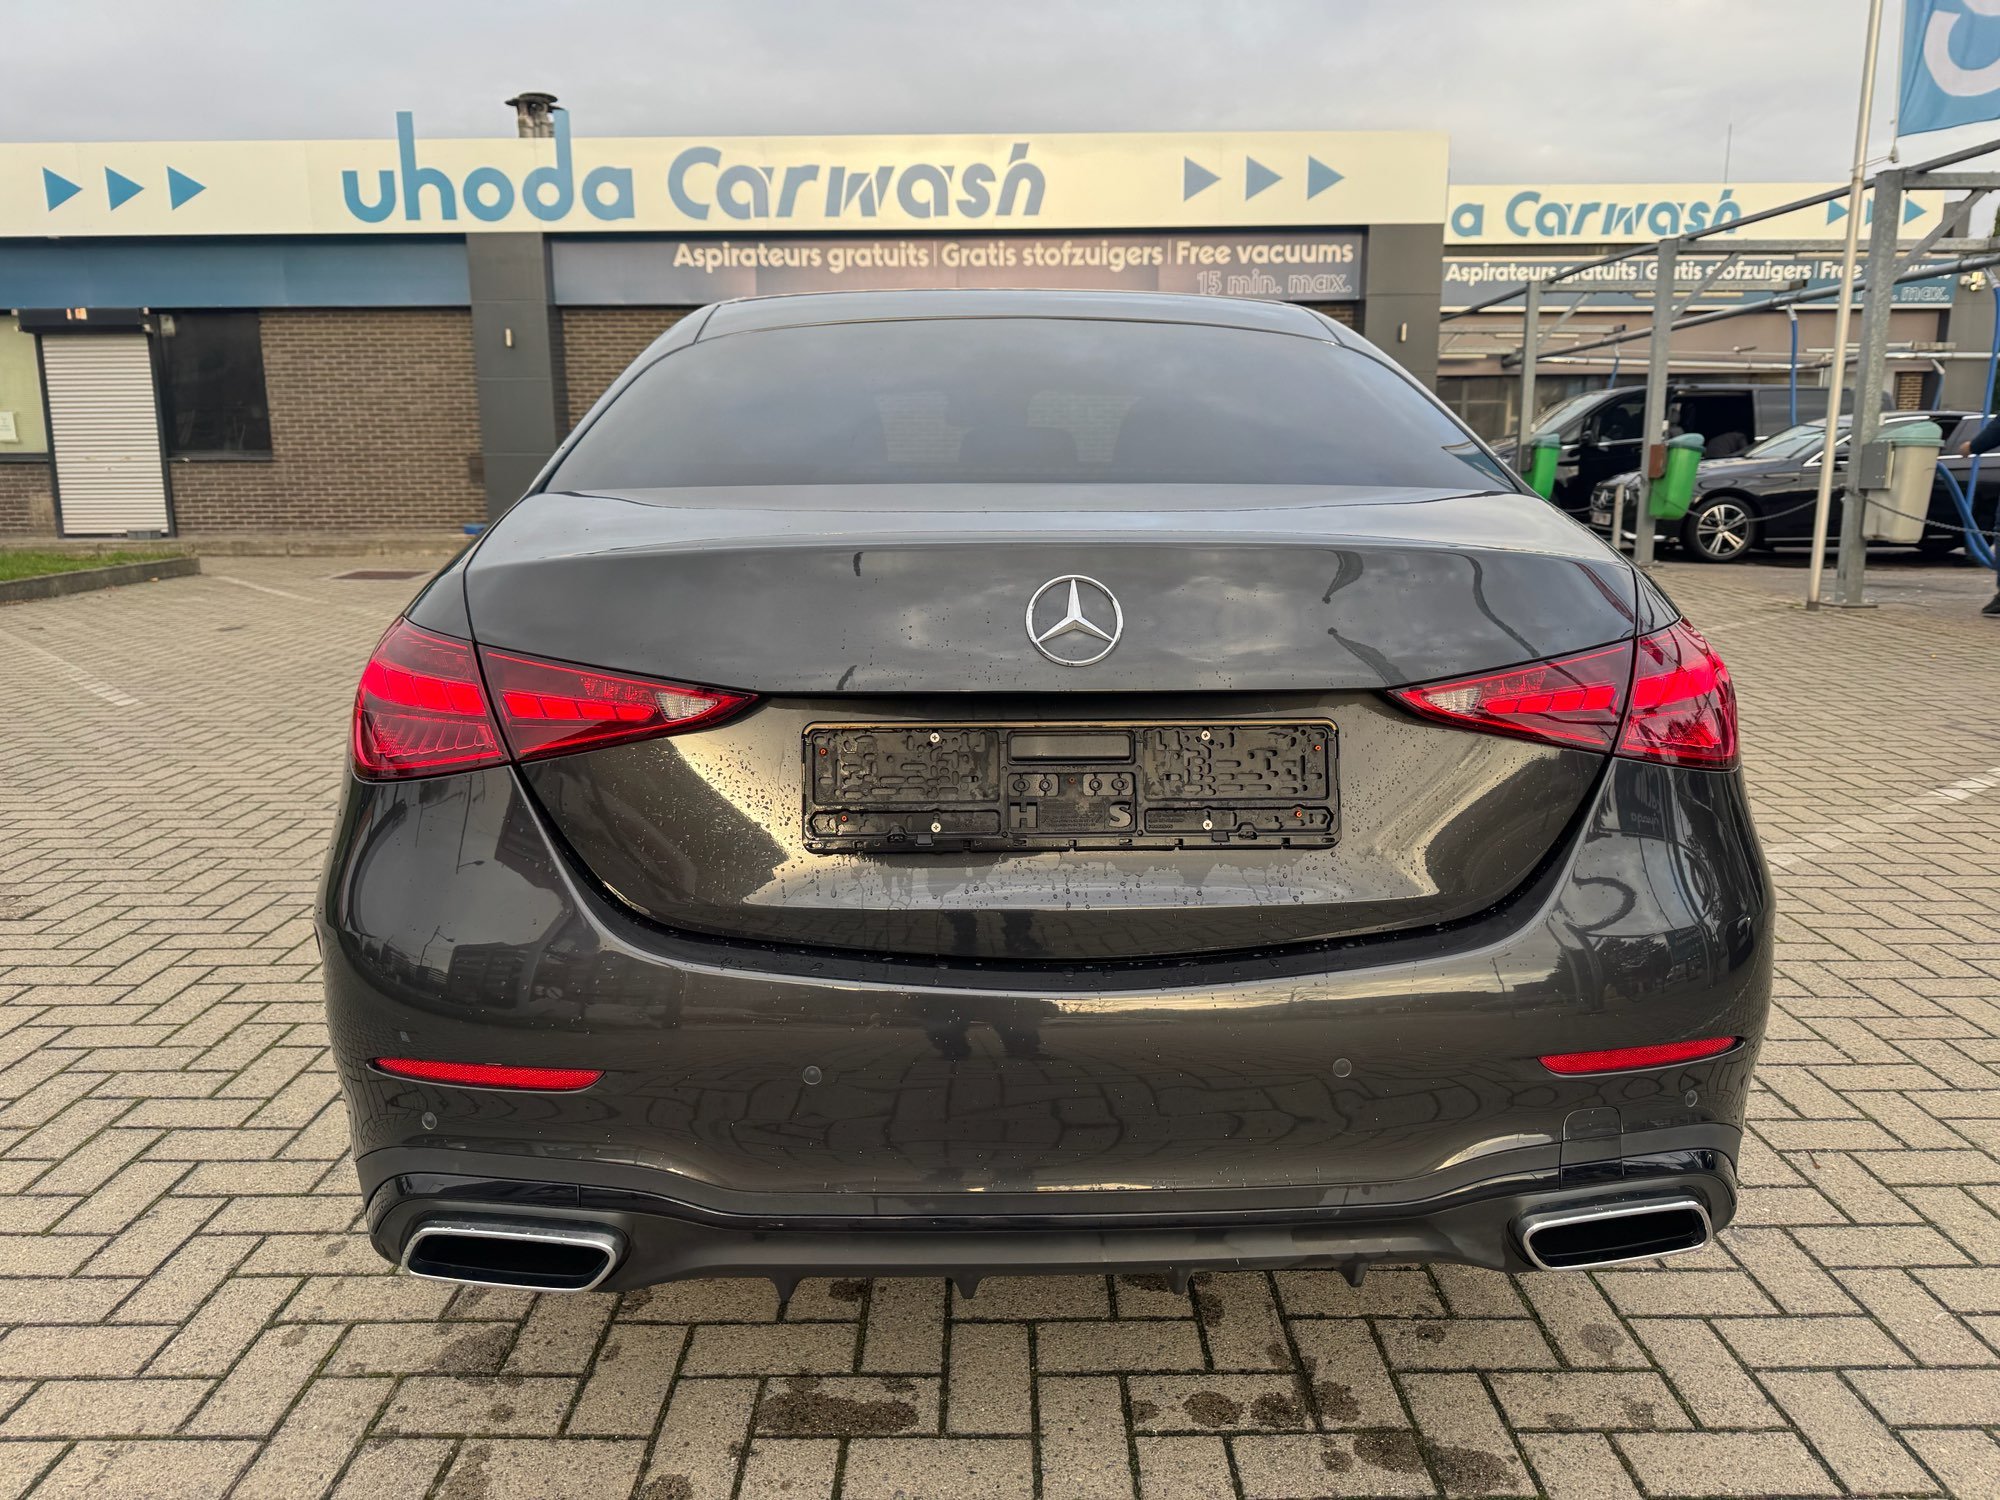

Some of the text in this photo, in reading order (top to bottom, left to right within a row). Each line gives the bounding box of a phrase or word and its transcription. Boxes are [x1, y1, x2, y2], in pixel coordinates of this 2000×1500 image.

[342, 108, 1046, 223] uhoda Carwash
[1505, 189, 1742, 237] Carwash
[673, 240, 1354, 274] Aspirateurs gratuits Gratis stofzuigers Free vacuums
[1197, 268, 1352, 294] 15 min. max.
[1445, 262, 1557, 287] Aspirateurs
[1900, 286, 1950, 301] max.
[1010, 802, 1037, 828] H
[1109, 801, 1132, 828] S
